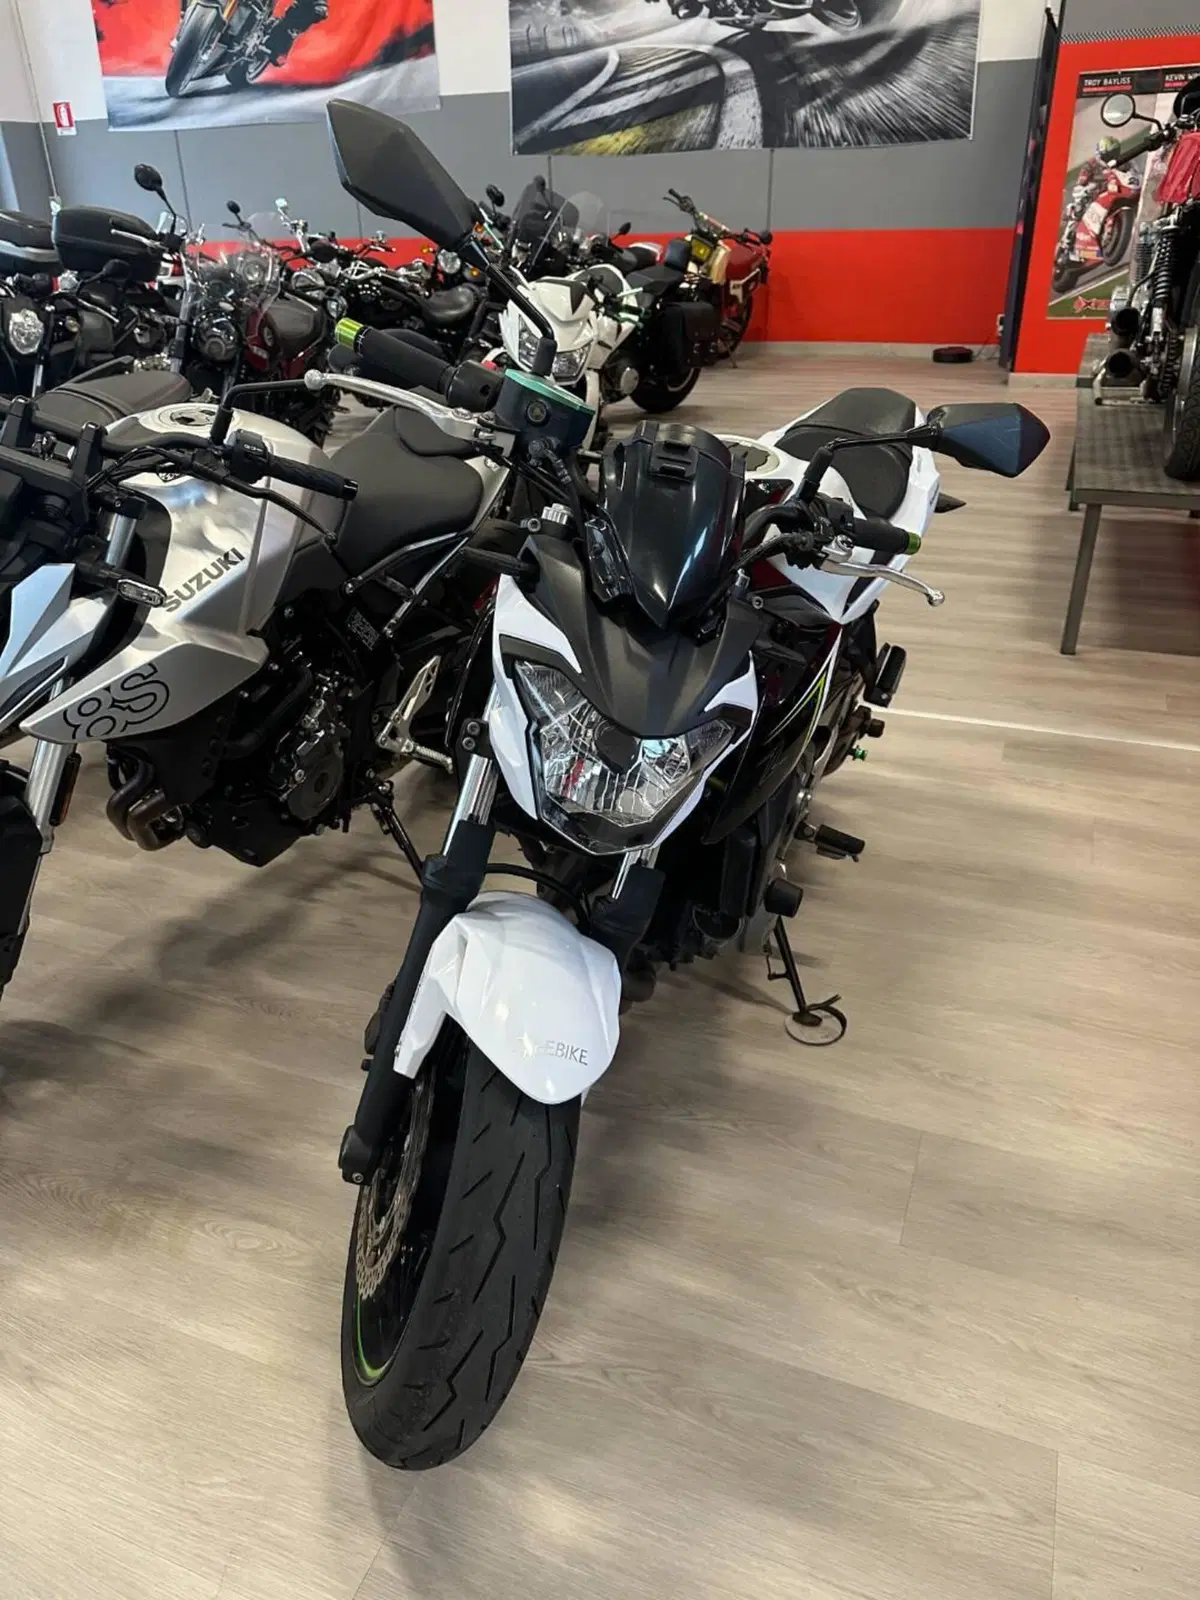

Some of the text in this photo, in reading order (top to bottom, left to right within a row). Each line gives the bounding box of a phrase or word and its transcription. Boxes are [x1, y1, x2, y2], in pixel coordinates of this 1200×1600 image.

[1103, 77, 1131, 86] BAYLISS
[1165, 73, 1185, 82] KEVIN
[163, 547, 245, 612] SUZUKI
